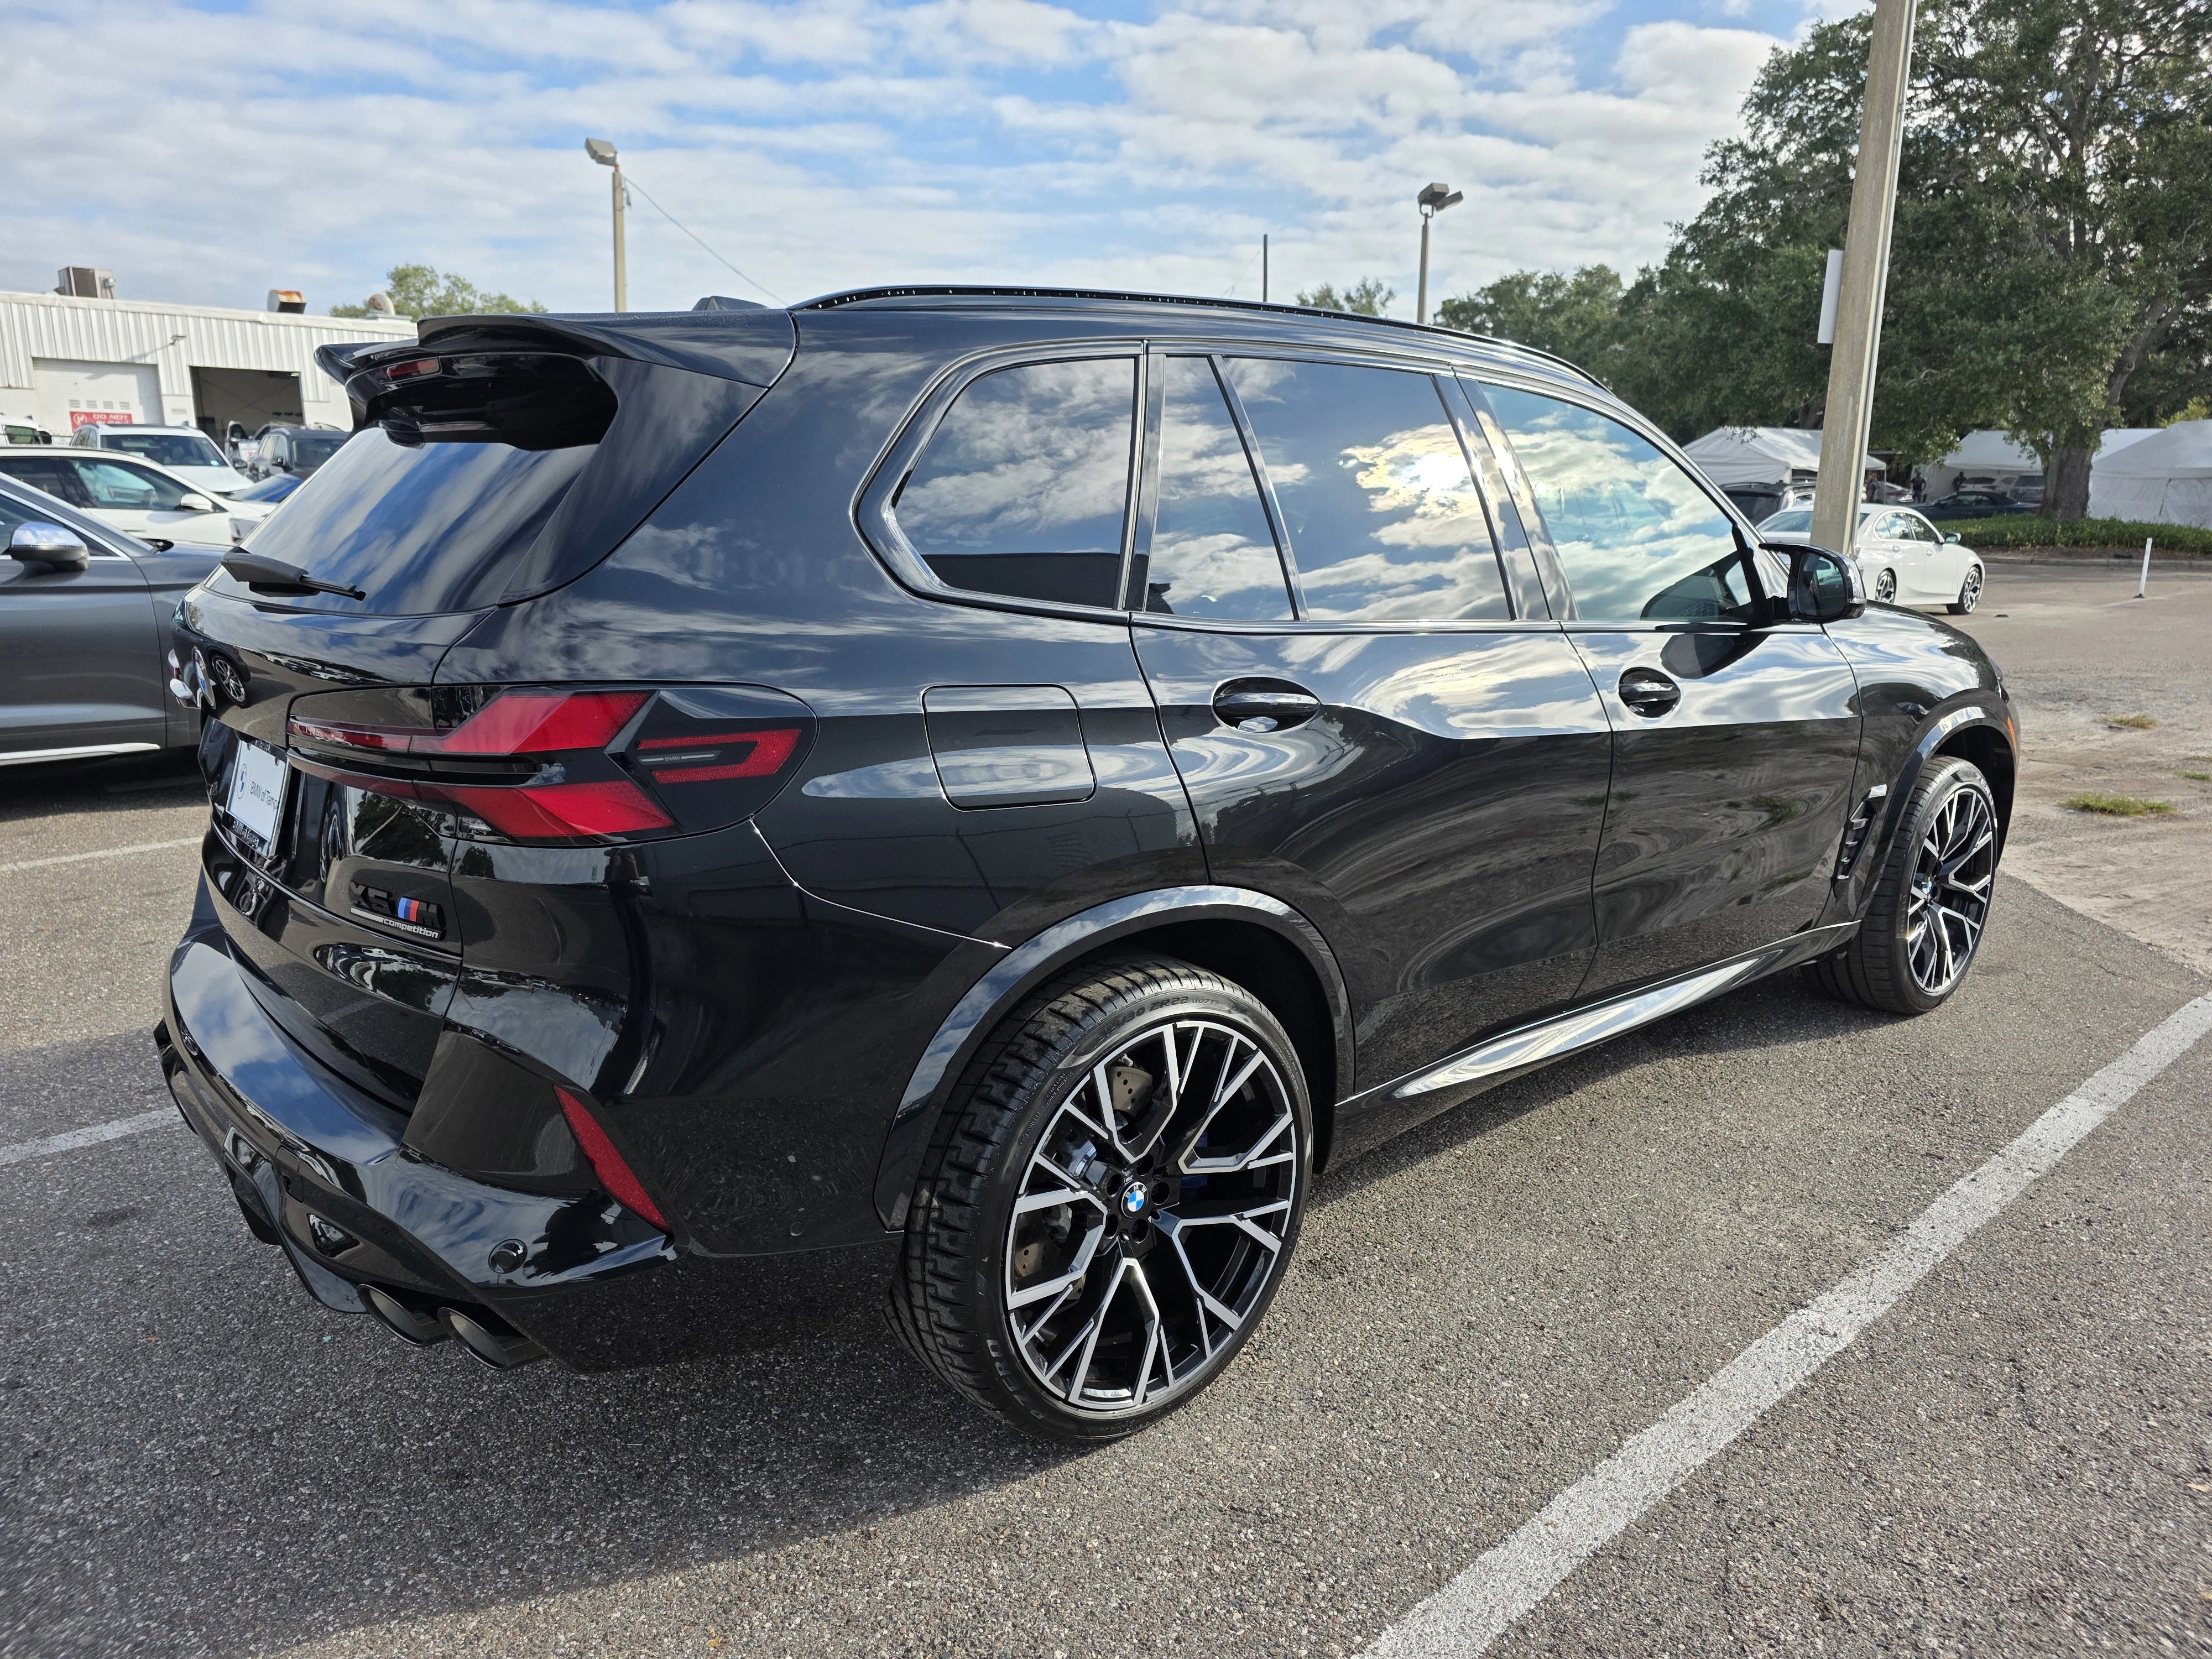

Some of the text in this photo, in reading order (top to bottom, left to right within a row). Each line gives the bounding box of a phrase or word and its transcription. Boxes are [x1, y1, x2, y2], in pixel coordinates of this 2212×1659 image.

[250, 781, 262, 800] BMW
[383, 917, 439, 939] competition
[1149, 996, 1189, 1013] ZR22
[1125, 1185, 1147, 1198] BMW
